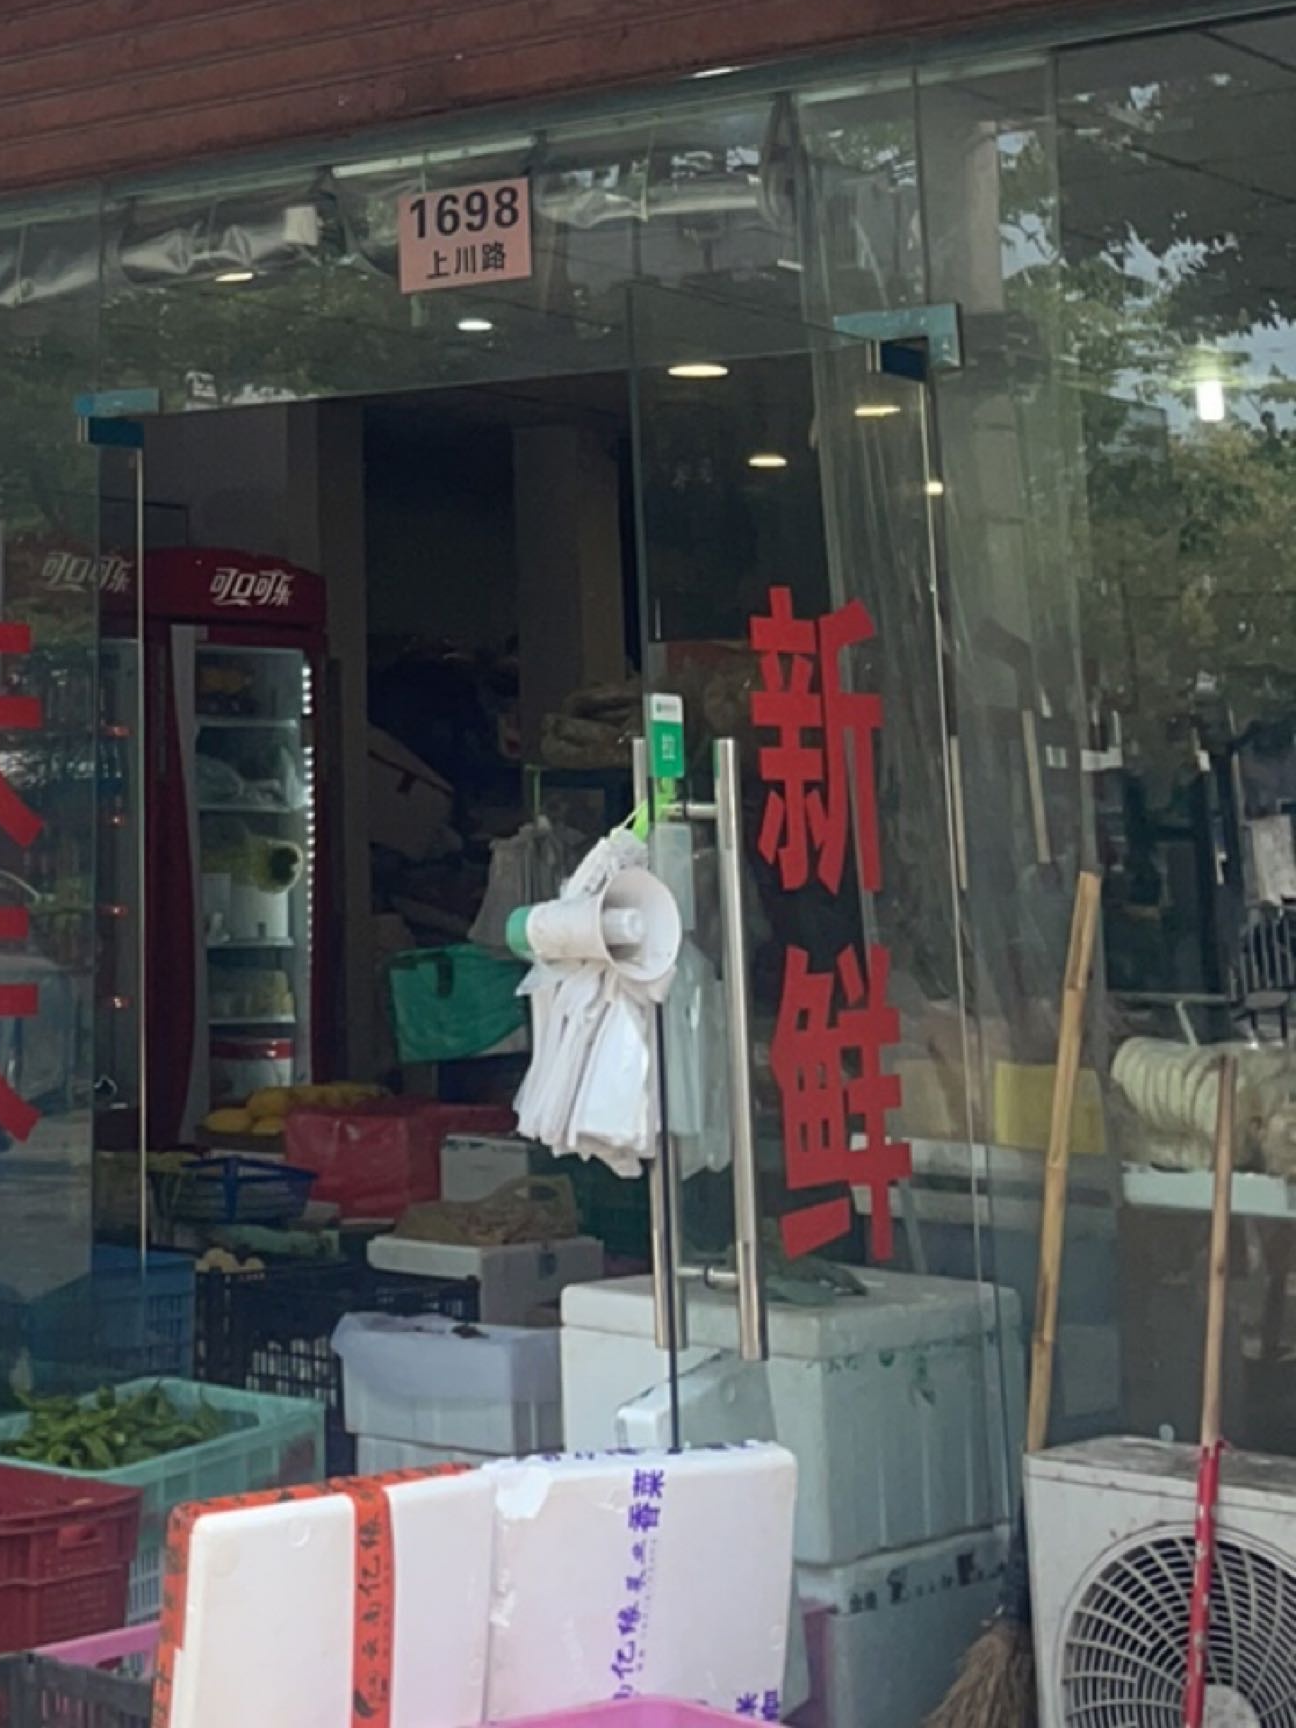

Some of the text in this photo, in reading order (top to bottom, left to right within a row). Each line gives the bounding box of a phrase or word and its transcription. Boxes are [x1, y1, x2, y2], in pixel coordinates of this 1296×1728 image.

[410, 186, 519, 239] 1698
[426, 240, 507, 280] 上川路
[209, 567, 295, 607] 可口可乐
[750, 586, 912, 1261] 新鲜
